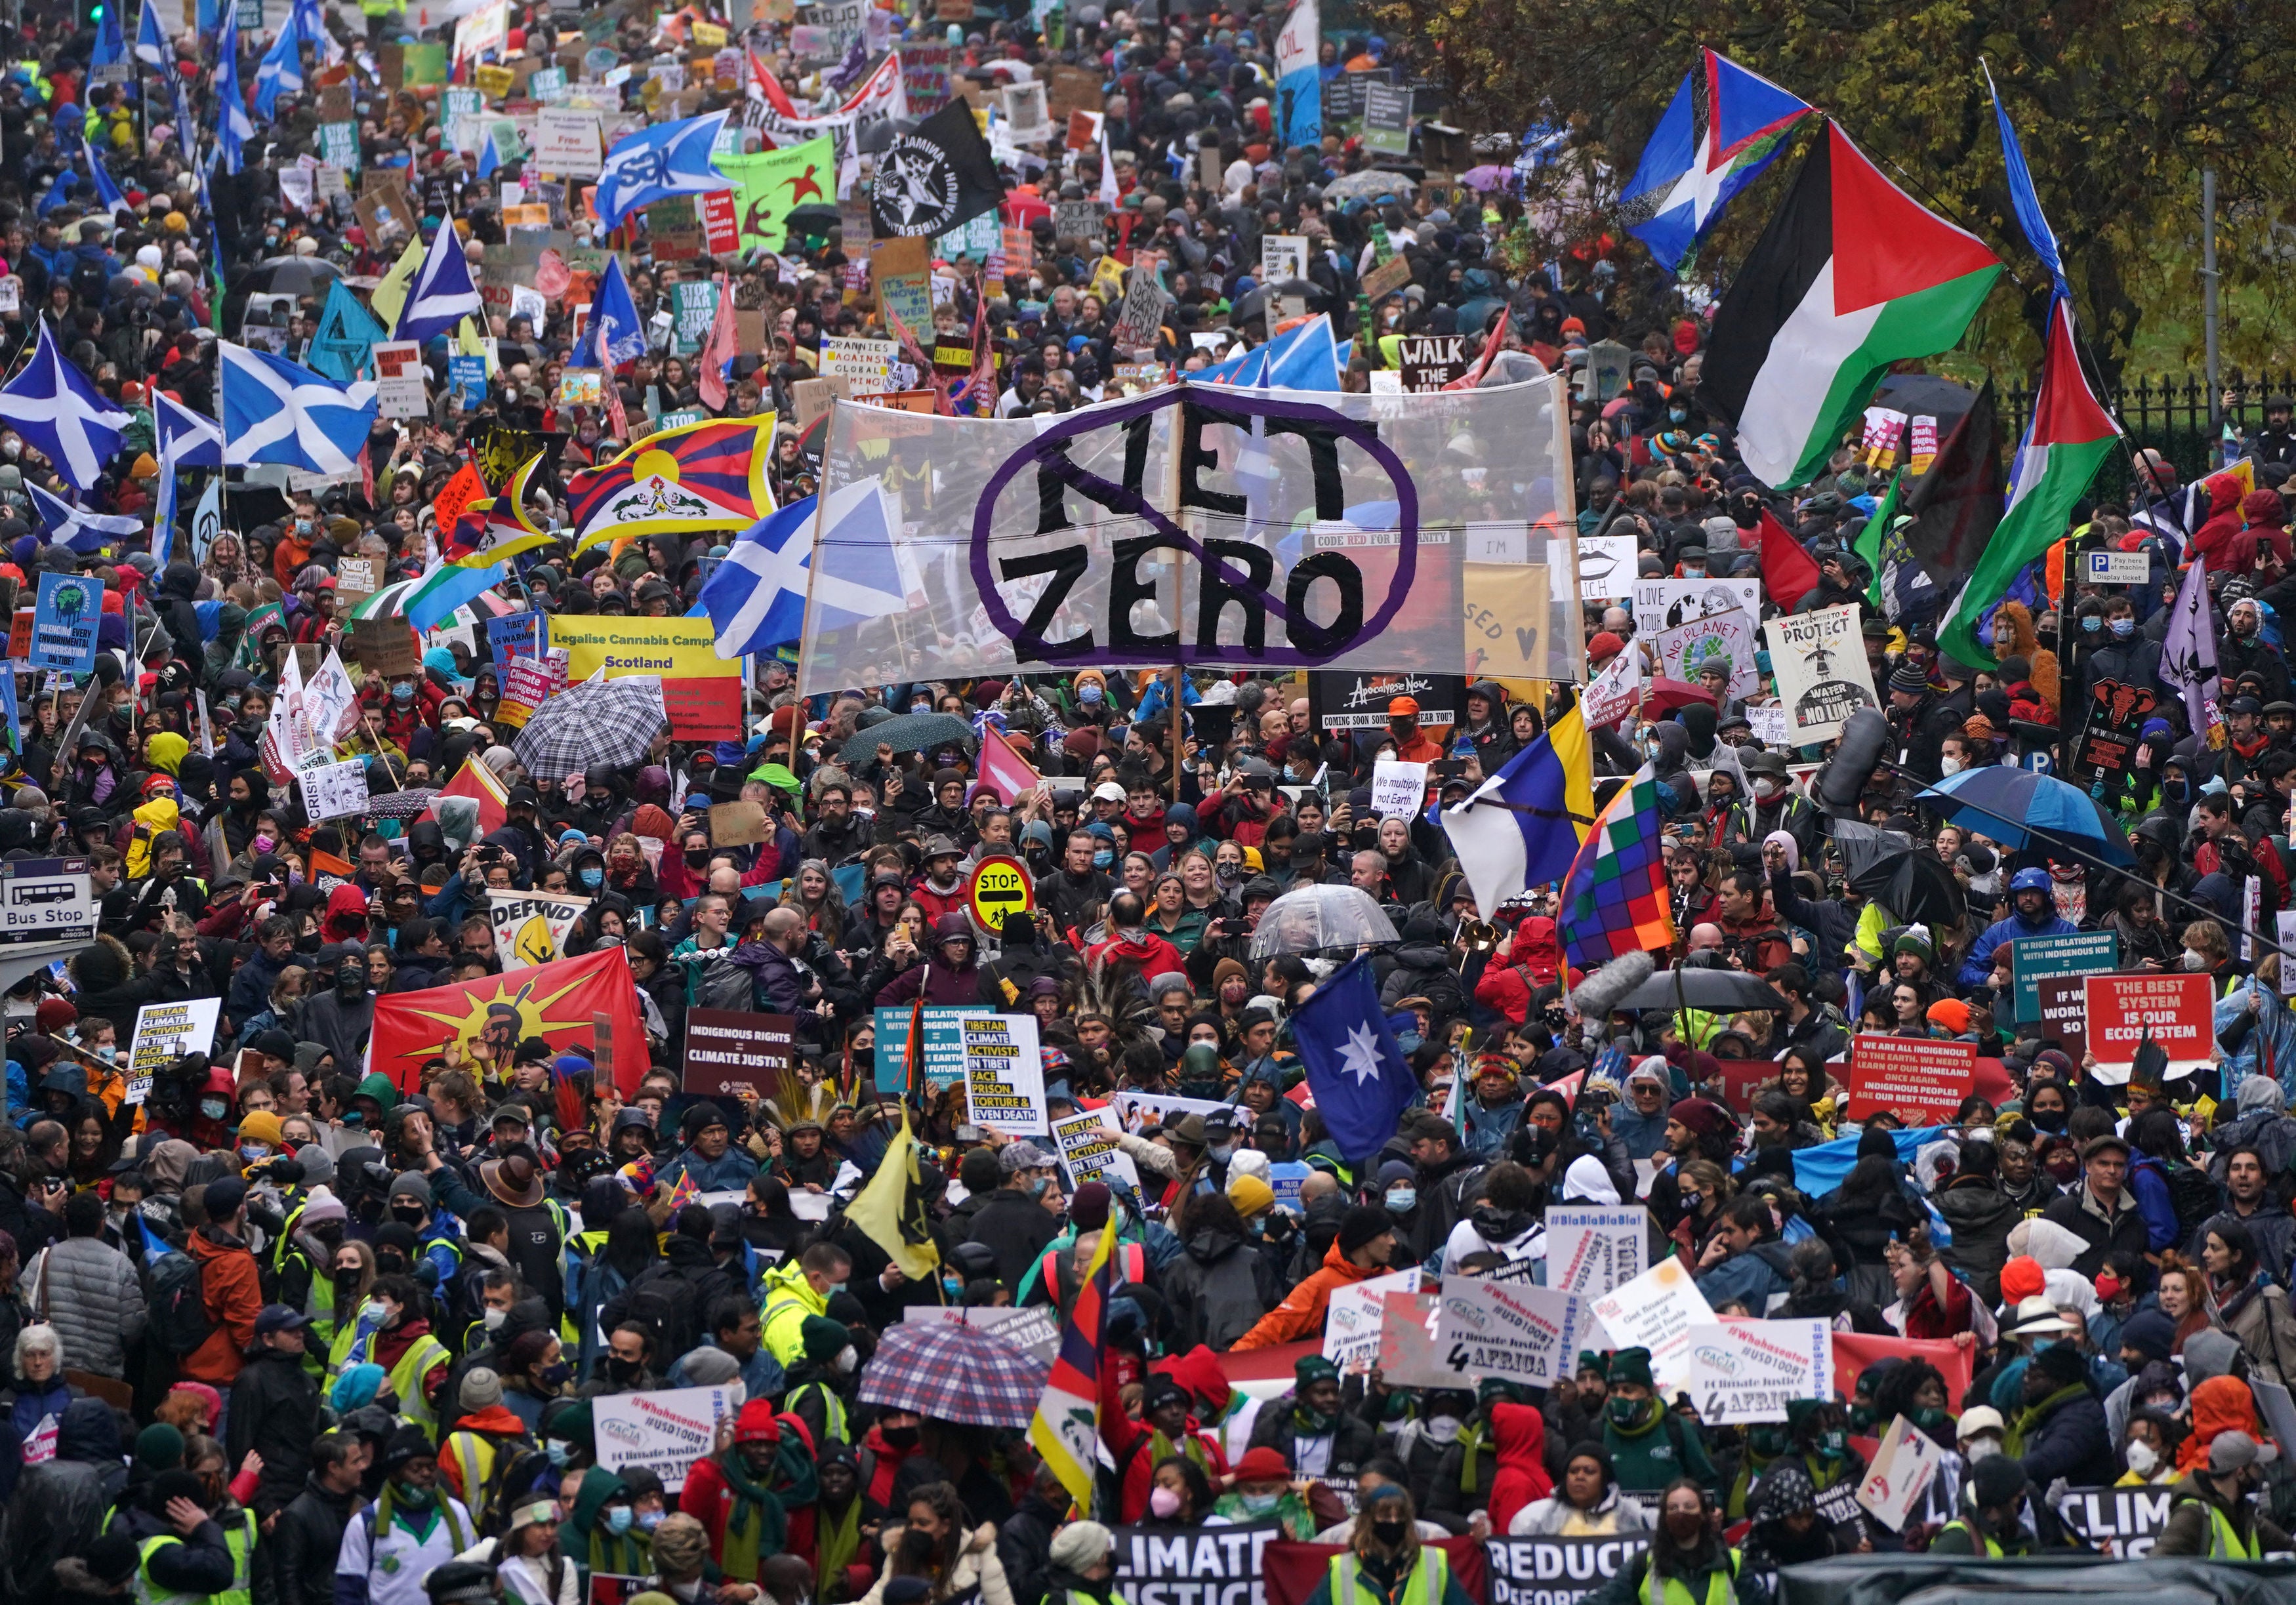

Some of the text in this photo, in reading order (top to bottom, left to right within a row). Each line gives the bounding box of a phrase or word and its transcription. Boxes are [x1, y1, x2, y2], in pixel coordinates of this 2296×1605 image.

[1058, 204, 1089, 218] STOP
[680, 283, 710, 296] STOP
[682, 295, 710, 308] WAR
[682, 309, 714, 321] STOP
[827, 340, 888, 355] GRANNIES
[1400, 338, 1464, 365] WALK
[835, 354, 886, 366] AGAINST
[834, 364, 878, 376] GLOBAL
[1117, 367, 1137, 376] ECO
[1417, 368, 1448, 384] THE
[1912, 436, 1936, 446] refugees
[1912, 444, 1936, 455] welcome
[807, 453, 820, 463] NOT
[1036, 411, 1378, 535] NET
[1318, 531, 1391, 547] CODE RED FOR
[2097, 573, 2120, 582] Display
[54, 579, 76, 591] CHINA
[76, 580, 91, 614] CONFLICT
[999, 531, 1364, 664] ZERO
[1637, 587, 1664, 605] LOVE
[505, 620, 525, 630] TIBET
[1639, 613, 1662, 631] YOUR
[39, 623, 92, 639] SILENCING EVERY
[1783, 618, 1849, 643] PROTECT
[554, 634, 669, 649] Legalise Cannabis
[39, 643, 87, 658] CONVERSATION
[48, 654, 76, 666] ON TIBET
[604, 656, 673, 670] Scotland
[510, 668, 541, 687] Climate
[1404, 674, 1433, 695] Now
[506, 680, 544, 699] refugees
[1810, 683, 1847, 699] WATER
[504, 691, 539, 709] welcome
[1748, 709, 1784, 718] FARMERS
[1826, 700, 1855, 722] LINE
[1324, 711, 1452, 727] COMING SOON YOU?
[264, 746, 281, 775] ECONOMY
[1376, 777, 1388, 787] We
[306, 771, 323, 821] CRISIS
[1377, 792, 1413, 805] not Earth.
[981, 874, 1019, 889] STOP
[7, 910, 84, 925] Bus Stop
[2030, 941, 2053, 949] RIGHT
[2055, 935, 2112, 947] RELATIONSHIP
[2045, 948, 2094, 959] INDIGENOUS
[2114, 980, 2184, 994] THE BEST
[2118, 996, 2180, 1009] SYSTEM
[144, 1006, 188, 1018] TIBETAN
[882, 1011, 893, 1021] IN
[2144, 1011, 2176, 1024] OUR
[142, 1015, 186, 1027] CLIMATE
[964, 1021, 1006, 1032] TIBETAN
[140, 1024, 194, 1037] ACTIVISTS
[691, 1025, 790, 1044] INDIGENOUS RIGHTS
[2104, 1026, 2196, 1041] ECOSYSTEM
[138, 1034, 177, 1046] IN TIBET
[966, 1033, 1009, 1044] CLIMATE
[136, 1046, 162, 1057] FACE
[689, 1049, 739, 1065] CLIMATE
[968, 1046, 1019, 1057] ACTIVISTS
[1897, 1044, 1912, 1052] ALL
[1914, 1046, 1968, 1057] INDIGENOUS
[969, 1059, 1009, 1070] IN TIBET
[1887, 1053, 1918, 1063] EARTH.
[1920, 1055, 1934, 1064] WE
[1935, 1057, 1958, 1066] NEED
[970, 1071, 997, 1082] FACE
[1857, 1061, 1886, 1070] LEARN
[1899, 1064, 1919, 1073] OUR
[1920, 1066, 1969, 1078] HOMELAND
[1885, 1073, 1940, 1086] ONCE AGAIN.
[1864, 1082, 1958, 1097] INDIGENOUS PEOPLES
[974, 1097, 1018, 1109] TORTURE
[1856, 1091, 1917, 1103] ARE OUR BEST
[974, 1110, 1036, 1122] EVEN DEATH
[1056, 1118, 1102, 1137] TIBETAN
[1071, 1153, 1112, 1173] IN TIBET
[1621, 1290, 1677, 1325] Get finance
[1641, 1304, 1670, 1326] out of
[1424, 1307, 1441, 1341] 4
[1635, 1307, 1687, 1341] fossil fuels
[1647, 1320, 1687, 1347] and into
[1446, 1343, 1548, 1377] 4 AFRICA
[1704, 1391, 1726, 1423] 4
